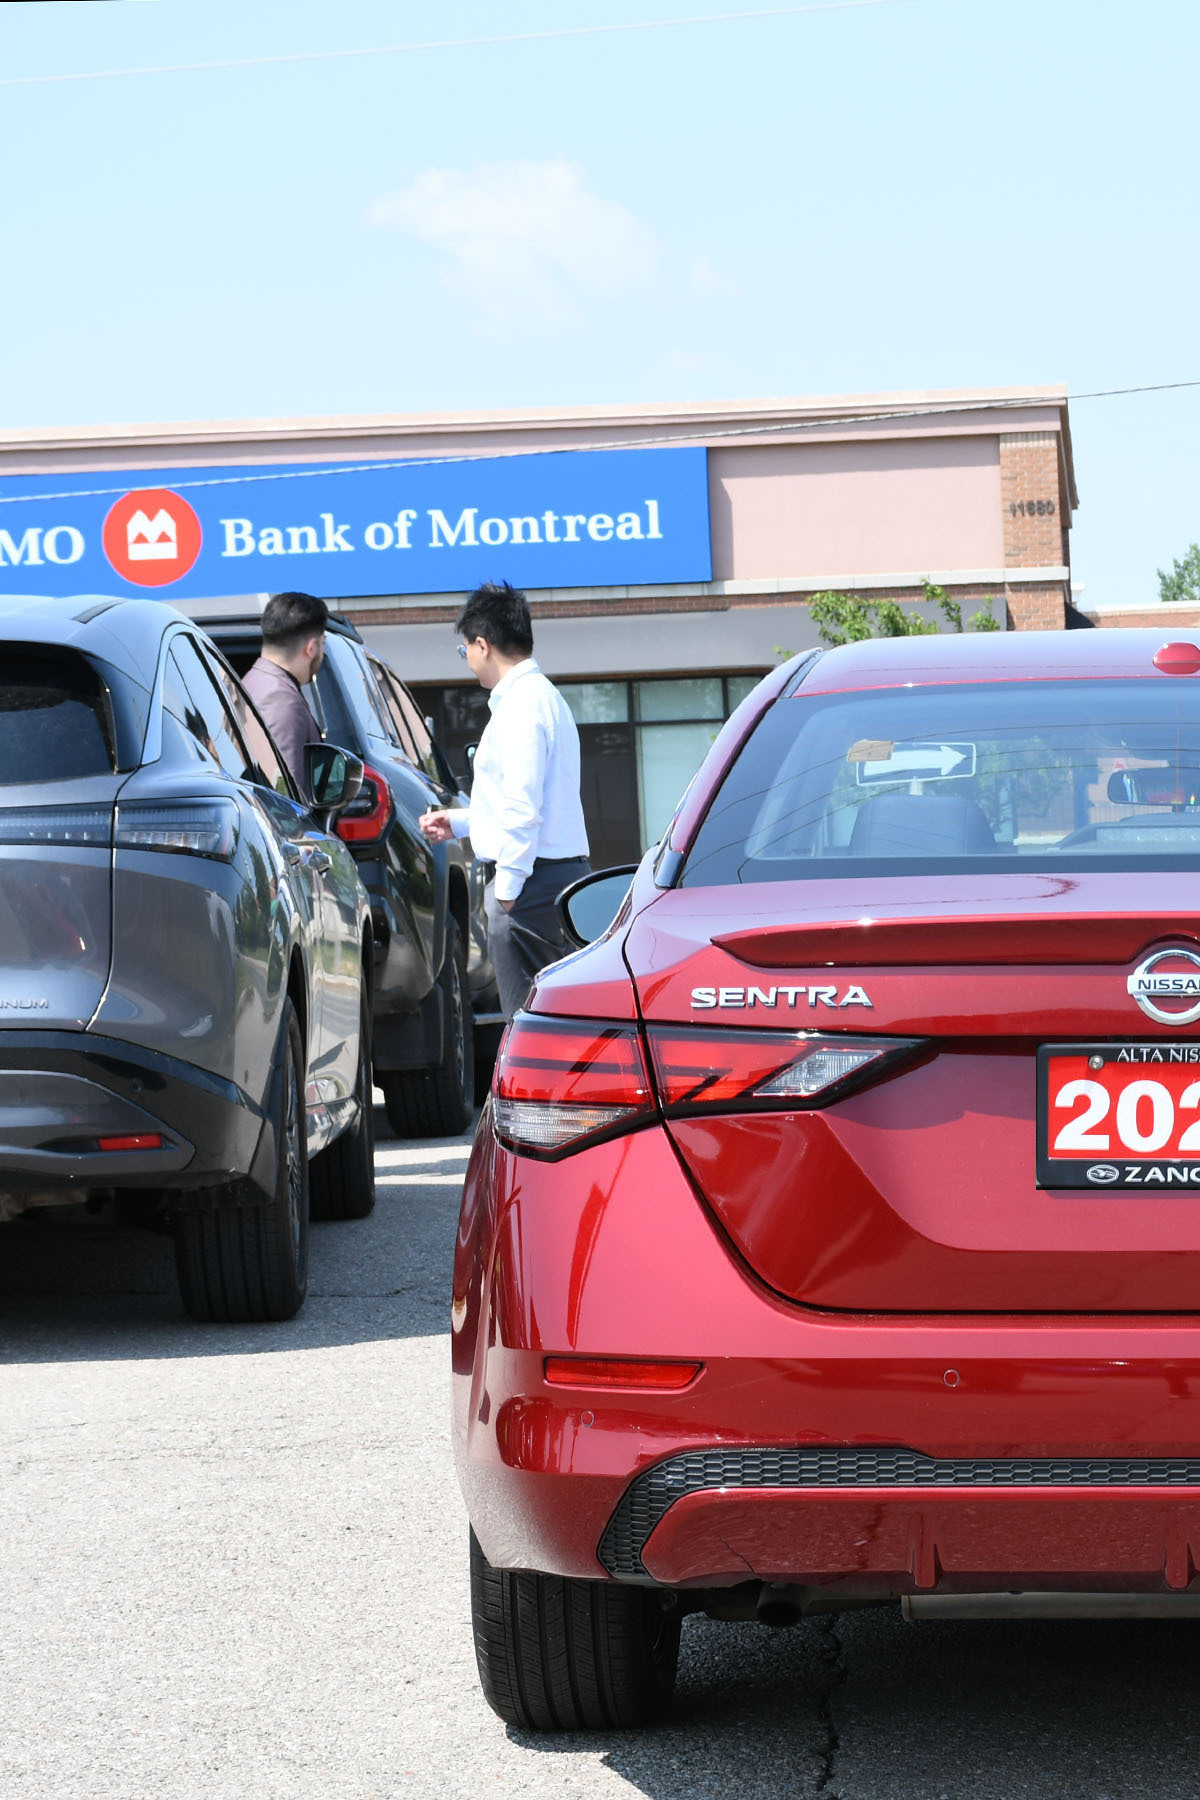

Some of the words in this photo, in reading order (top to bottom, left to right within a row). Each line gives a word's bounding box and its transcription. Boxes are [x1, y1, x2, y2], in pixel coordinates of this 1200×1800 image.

[219, 513, 355, 557] Bank
[364, 509, 418, 551] of
[427, 500, 663, 548] Montreal
[689, 985, 874, 1008] SENTRA
[1117, 1048, 1165, 1063] ALTA
